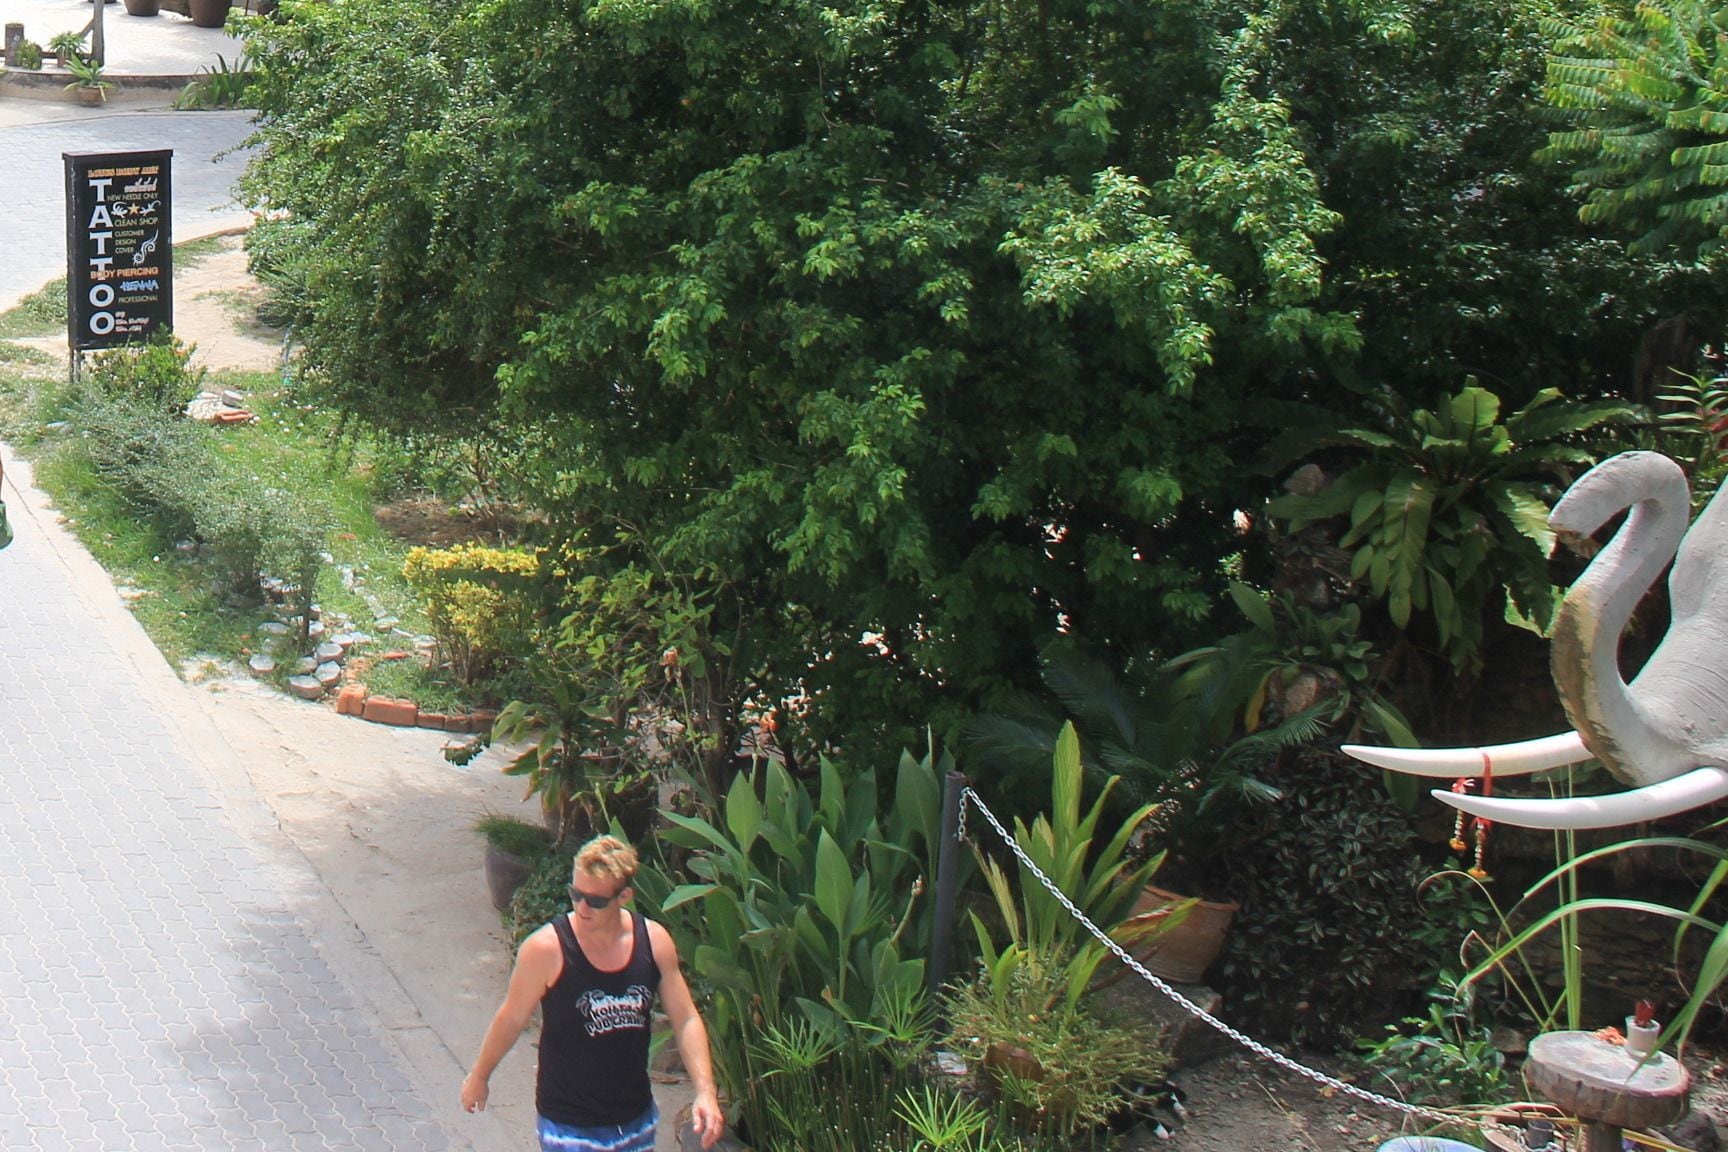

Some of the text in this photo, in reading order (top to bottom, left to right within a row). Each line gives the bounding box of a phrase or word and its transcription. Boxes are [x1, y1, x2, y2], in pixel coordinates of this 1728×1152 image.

[123, 193, 141, 201] NEEDLE
[114, 217, 159, 227] CLEAN SHOP
[114, 229, 144, 237] CUSTOMER
[88, 178, 115, 335] TATTOO
[90, 266, 159, 279] BODY PIERCING
